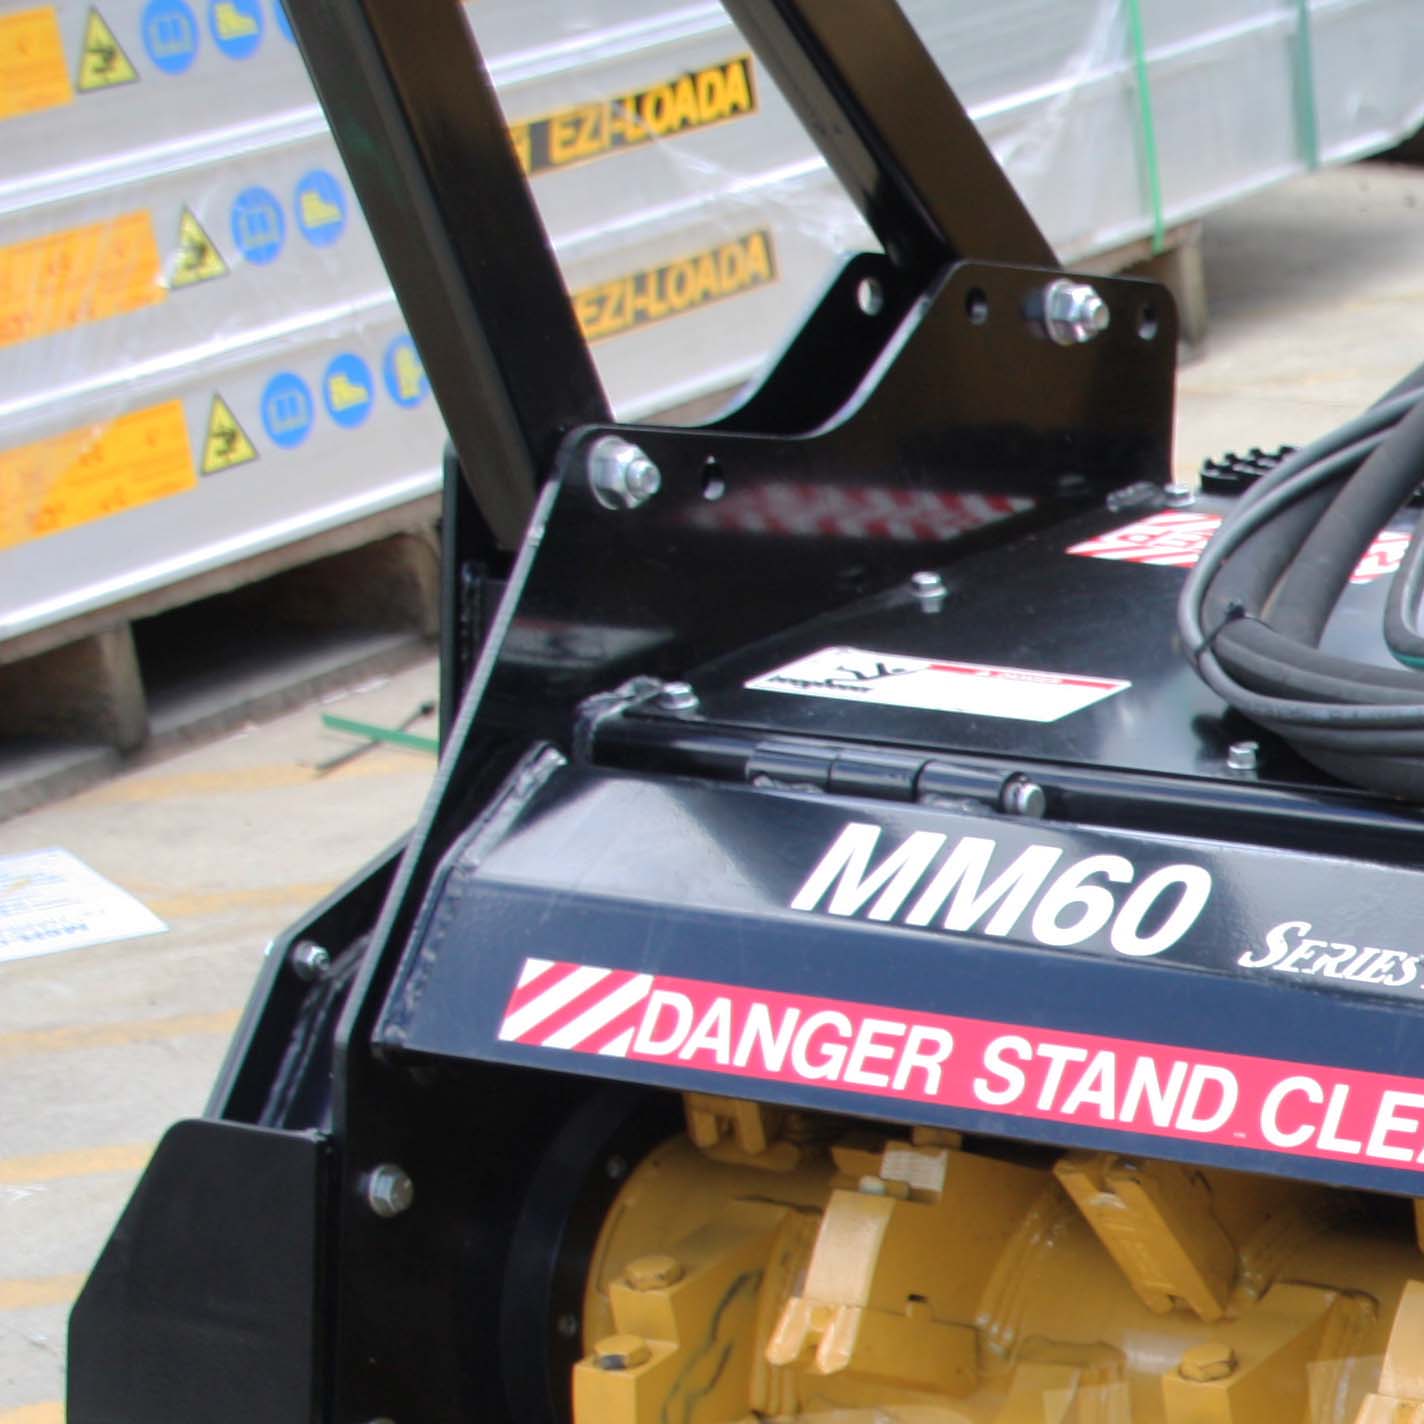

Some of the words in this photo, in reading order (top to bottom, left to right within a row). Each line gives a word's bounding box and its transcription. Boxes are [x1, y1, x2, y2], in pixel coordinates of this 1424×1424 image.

[550, 60, 751, 165] EZI-LOADA
[575, 232, 772, 338] EZI-LOADA
[790, 822, 1212, 957] MM60
[632, 989, 953, 1095] DANGER
[972, 1035, 1239, 1134] STAND
